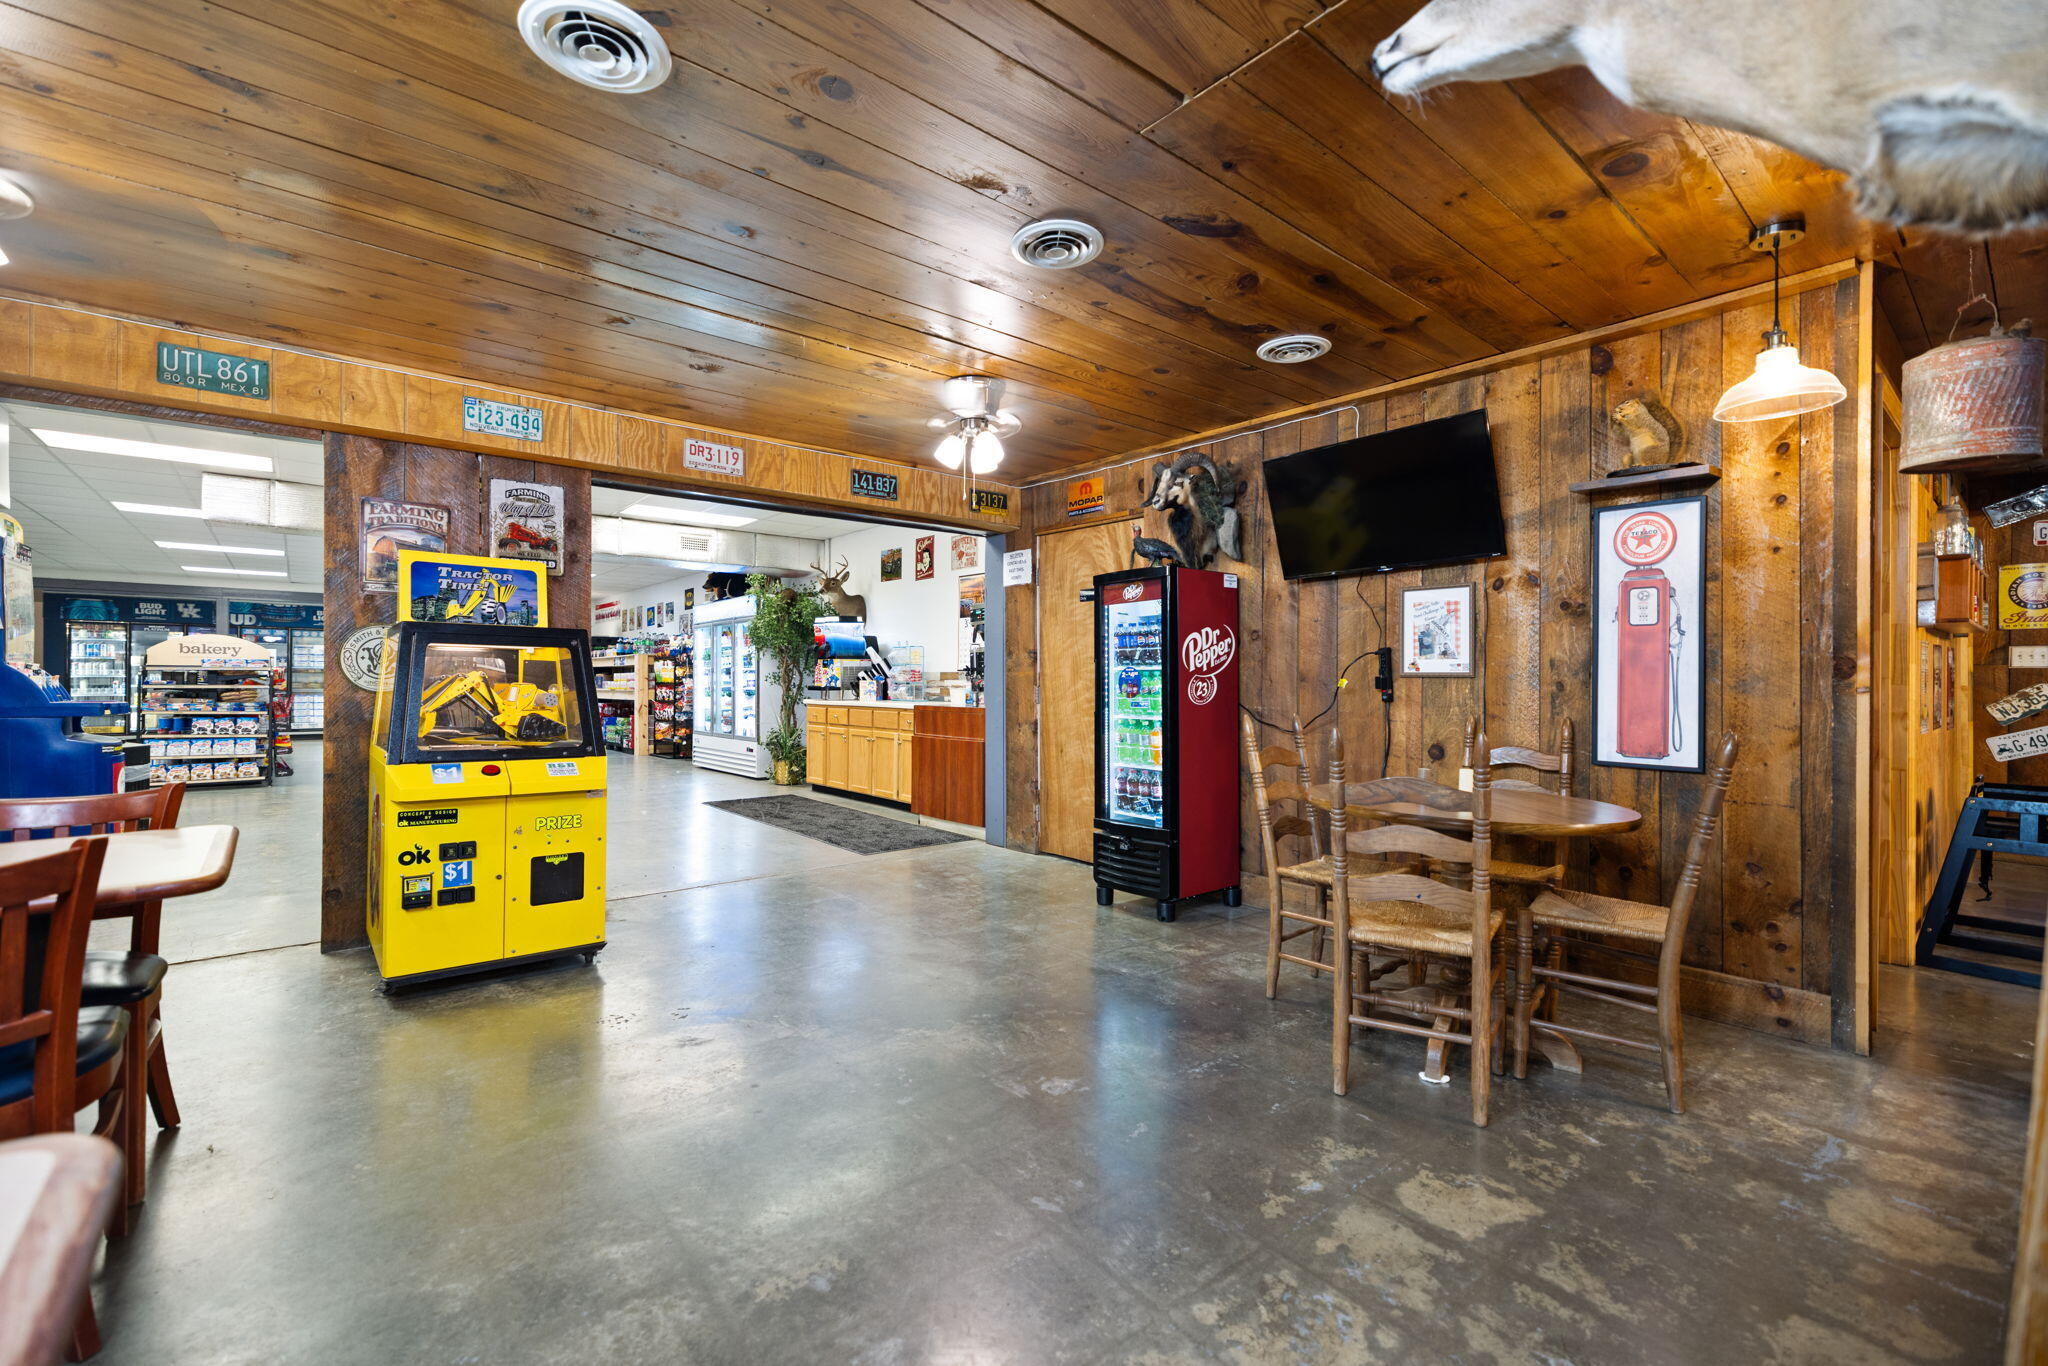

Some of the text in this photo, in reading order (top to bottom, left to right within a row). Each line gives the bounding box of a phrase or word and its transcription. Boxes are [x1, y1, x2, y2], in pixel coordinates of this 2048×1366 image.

[163, 347, 260, 386] UTL 861
[163, 372, 181, 382] 80
[221, 381, 247, 393] MEX
[469, 422, 499, 432] NOUVEAU
[505, 488, 551, 503] FARMING
[1068, 495, 1103, 508] MOPAR
[368, 502, 445, 522] FARMING
[499, 502, 524, 516] Way
[368, 516, 445, 533] TRADITIONS
[1631, 529, 1659, 537] TEXACO
[2009, 578, 2022, 604] INDIAN
[134, 608, 167, 616] LIGHT
[230, 613, 257, 626] UD
[350, 629, 374, 649] SMITH
[1201, 626, 1220, 651] Dr
[178, 643, 242, 658] bakery
[1183, 632, 1232, 673] Pepper
[1196, 681, 1208, 697] 23
[2012, 734, 2048, 752] G-49
[434, 767, 458, 777] $1
[409, 818, 457, 826] MANUFACTURING
[535, 814, 583, 831] PRIZE
[445, 861, 468, 882] $1
